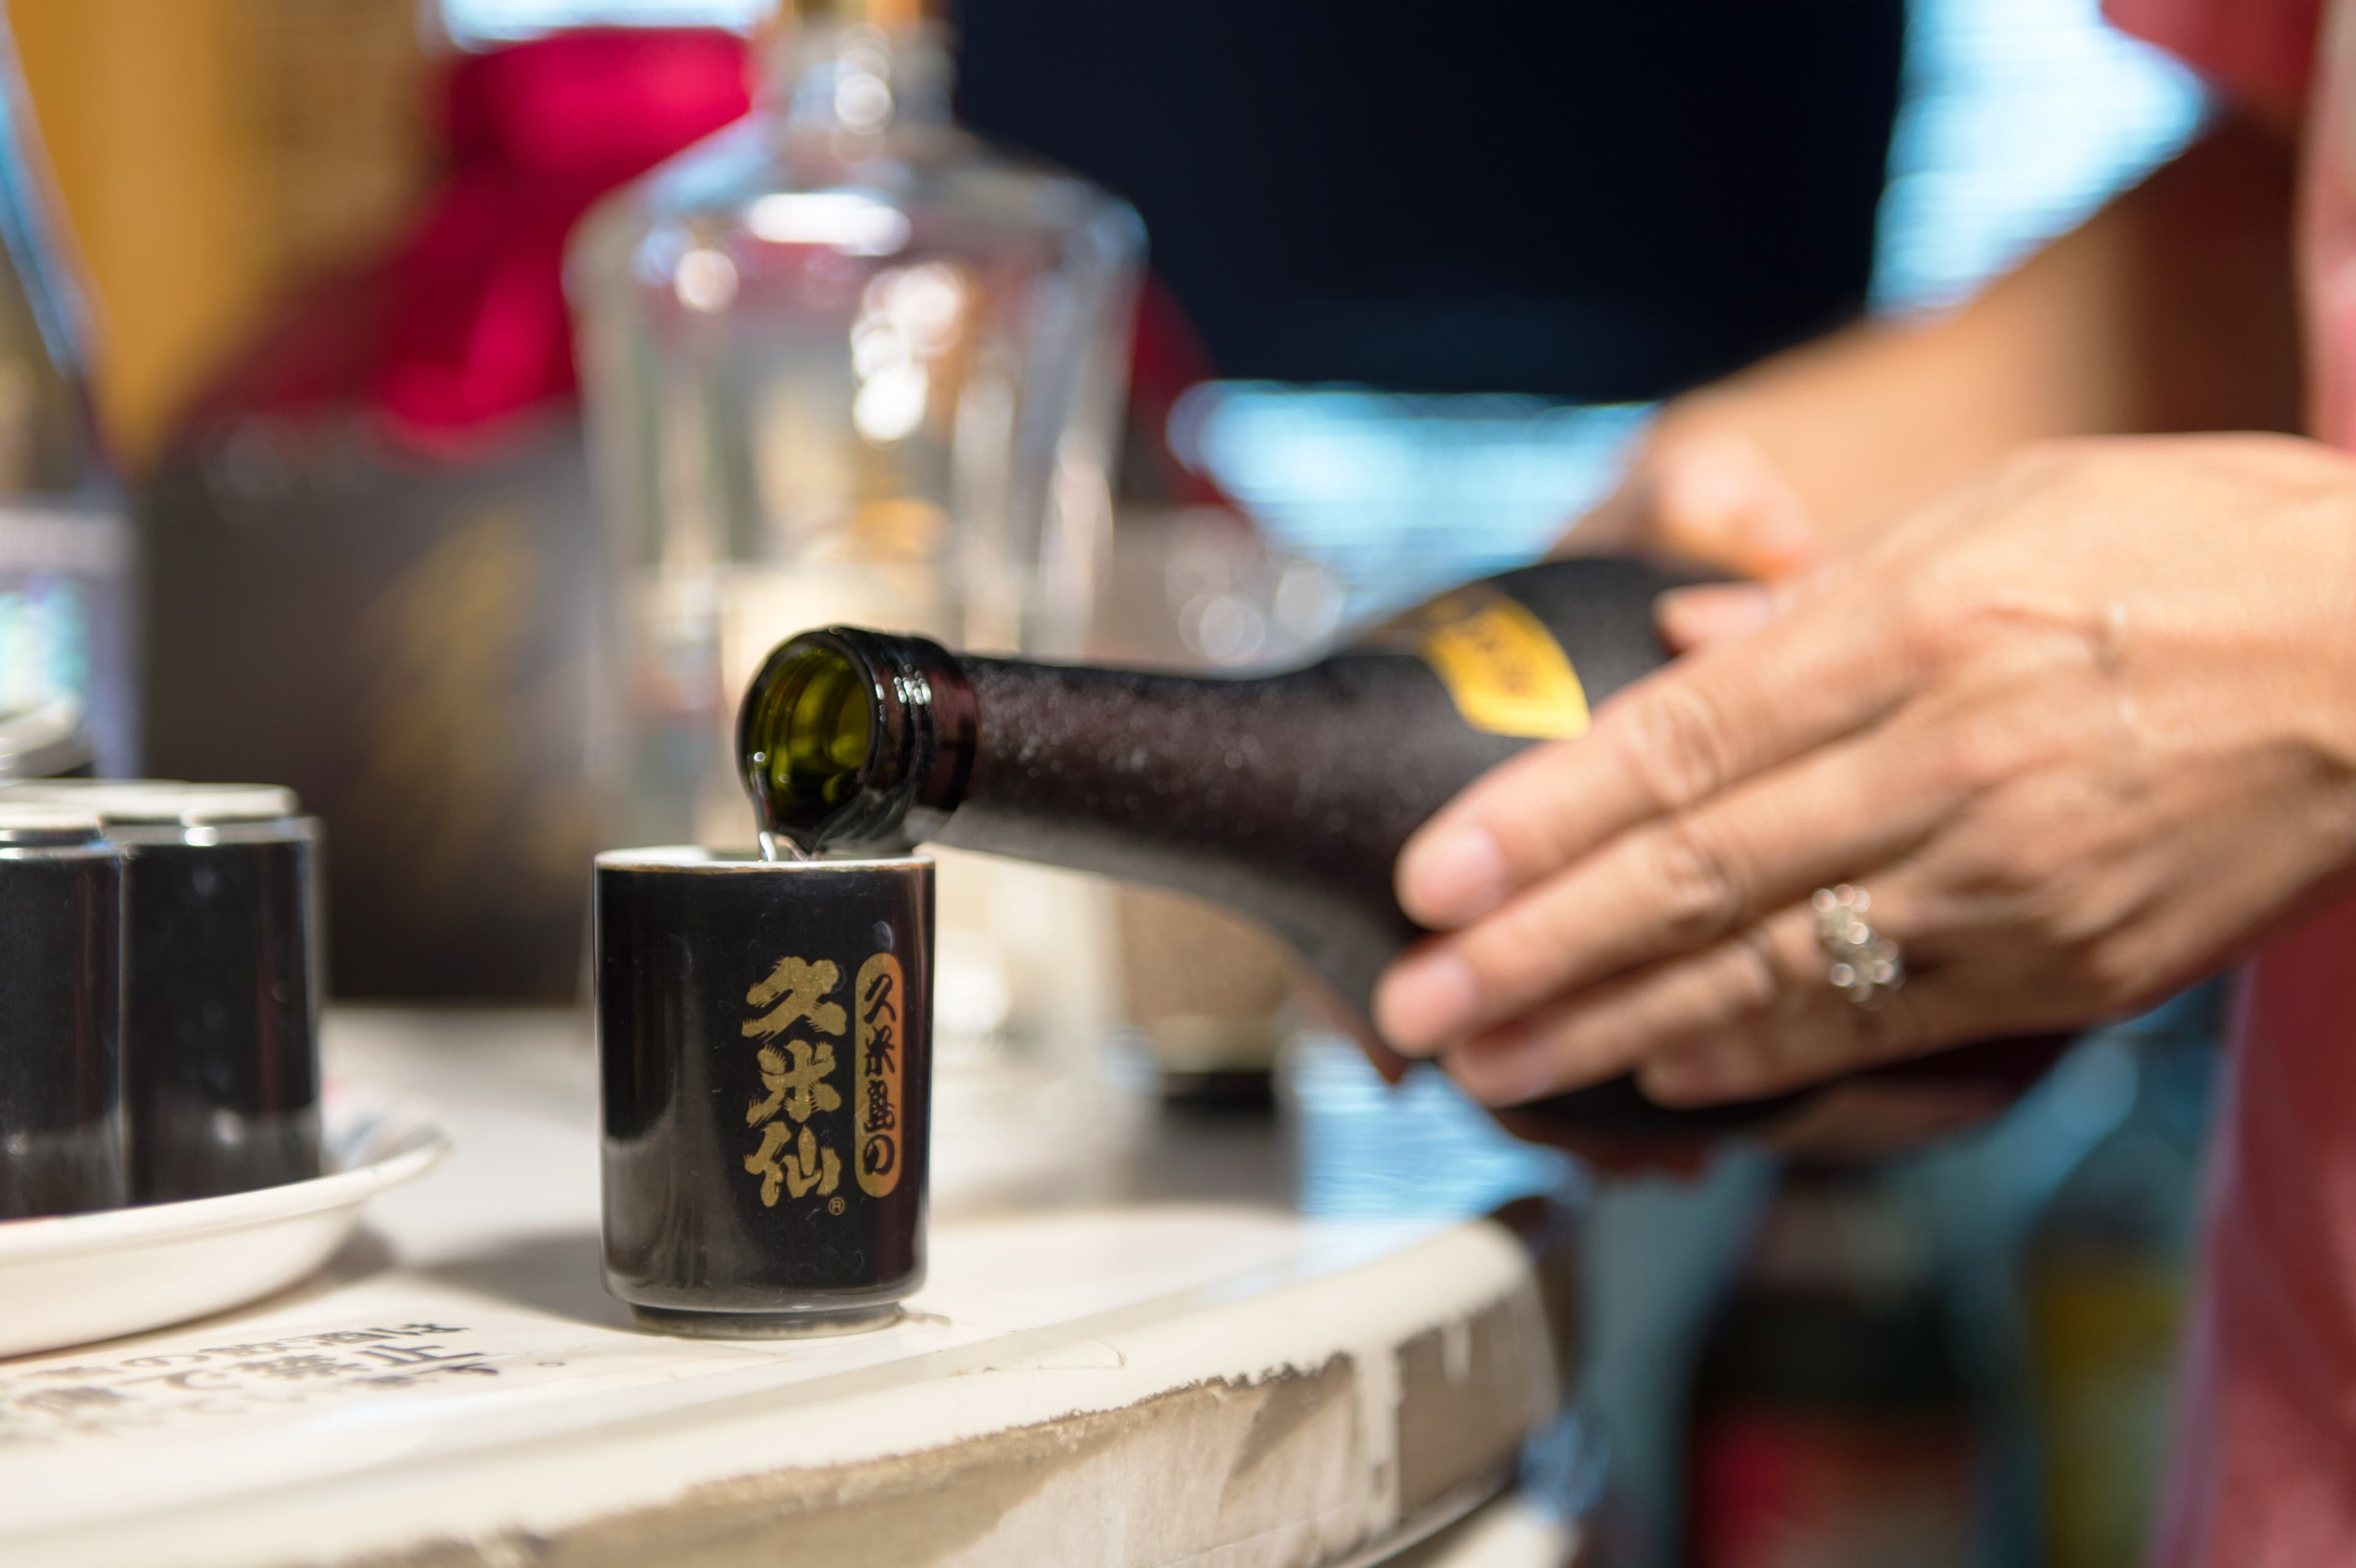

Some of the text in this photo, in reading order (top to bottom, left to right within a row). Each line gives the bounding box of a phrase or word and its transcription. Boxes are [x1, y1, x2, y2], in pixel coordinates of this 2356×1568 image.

[741, 955, 848, 1208] 久米仙
[863, 974, 896, 1177] 久米島の
